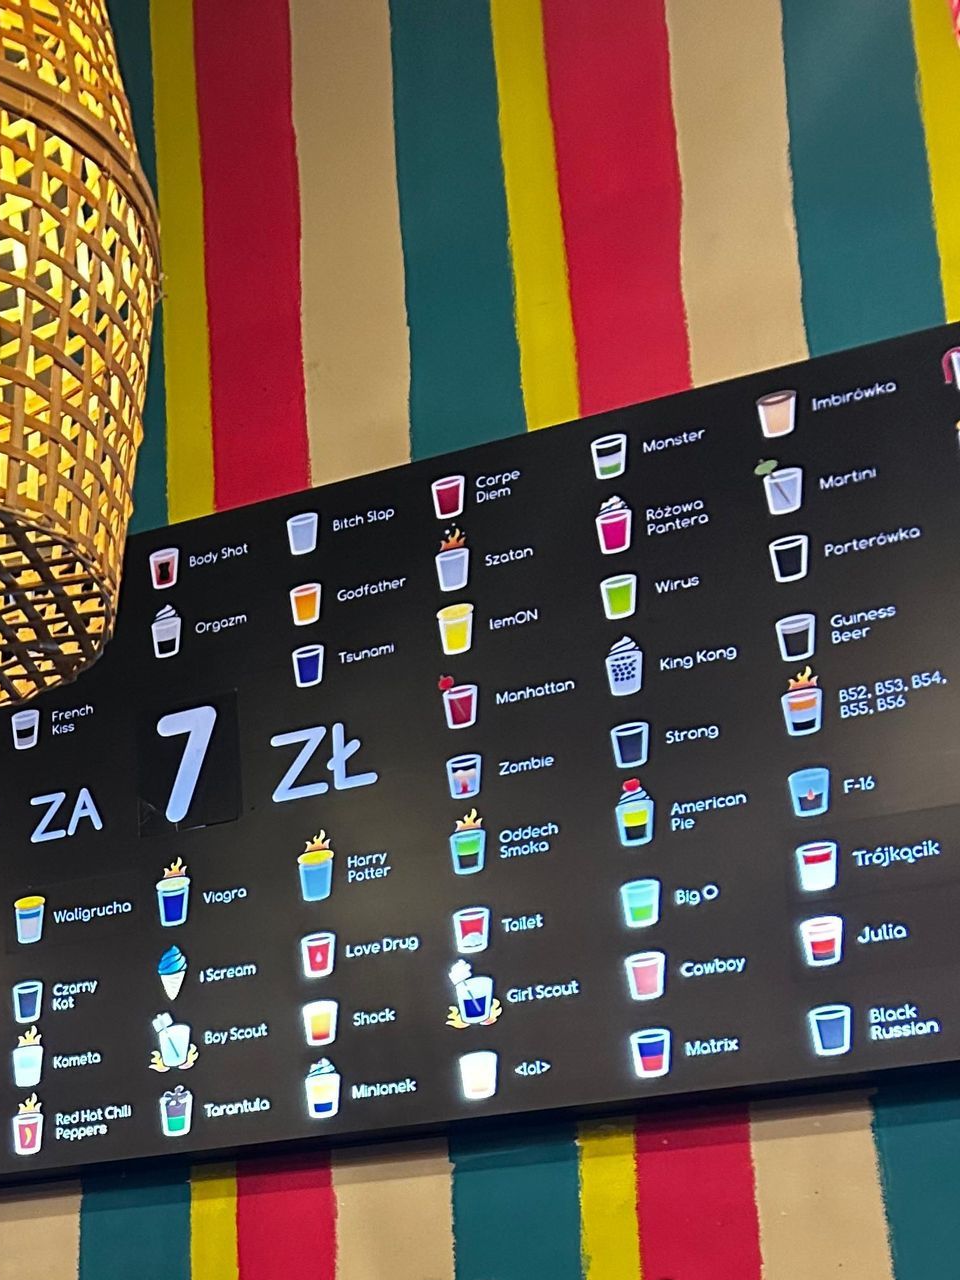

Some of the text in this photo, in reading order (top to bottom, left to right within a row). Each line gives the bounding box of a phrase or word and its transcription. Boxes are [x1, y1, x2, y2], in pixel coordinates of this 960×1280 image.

[811, 379, 897, 412] Imbirówka
[642, 428, 706, 453] Monster
[475, 469, 521, 489] Carpe
[818, 466, 877, 491] Martini
[476, 486, 511, 503] Diem
[332, 507, 395, 531] Bitch Slap
[646, 500, 704, 521] Różowa
[646, 513, 709, 536] Pantera
[824, 525, 921, 557] Porterówka
[189, 543, 249, 567] Body Shot
[484, 546, 534, 567] Szatan
[336, 577, 407, 602] Godfather
[655, 575, 700, 593] Wirus
[195, 613, 248, 634] Orgazm
[831, 624, 871, 645] Beer
[338, 643, 395, 664] Tsunami
[659, 647, 737, 671] King Kong
[495, 679, 575, 705] Manhattan
[51, 704, 94, 722] French
[51, 722, 75, 735] Kiss
[665, 725, 720, 745] Strong
[156, 705, 379, 823] 7 ZŁ
[498, 754, 555, 776] Zombie
[843, 776, 876, 793] F-16
[670, 792, 748, 816] American
[30, 787, 103, 844] ZA
[671, 817, 696, 832] Pie
[499, 822, 559, 844] Oddech
[347, 852, 387, 868] Harry
[499, 840, 550, 859] Smoka
[852, 840, 941, 867] Trójkącik
[347, 865, 392, 883] Potter
[202, 887, 247, 904] Viagra
[674, 884, 719, 906] Big O
[501, 913, 544, 932] Toilet
[856, 923, 907, 945] Julia
[344, 936, 419, 958] Love Drug
[680, 956, 746, 978] Cowboy
[506, 980, 580, 1003] Girl Scout
[352, 1008, 396, 1026] Shock
[869, 1003, 917, 1024] Black
[870, 1018, 940, 1041] Russian
[684, 1037, 740, 1057] Matrix
[52, 1052, 102, 1069] Kometa
[55, 1105, 132, 1126] Red Hot Chili
[55, 1123, 108, 1141] Peppers
